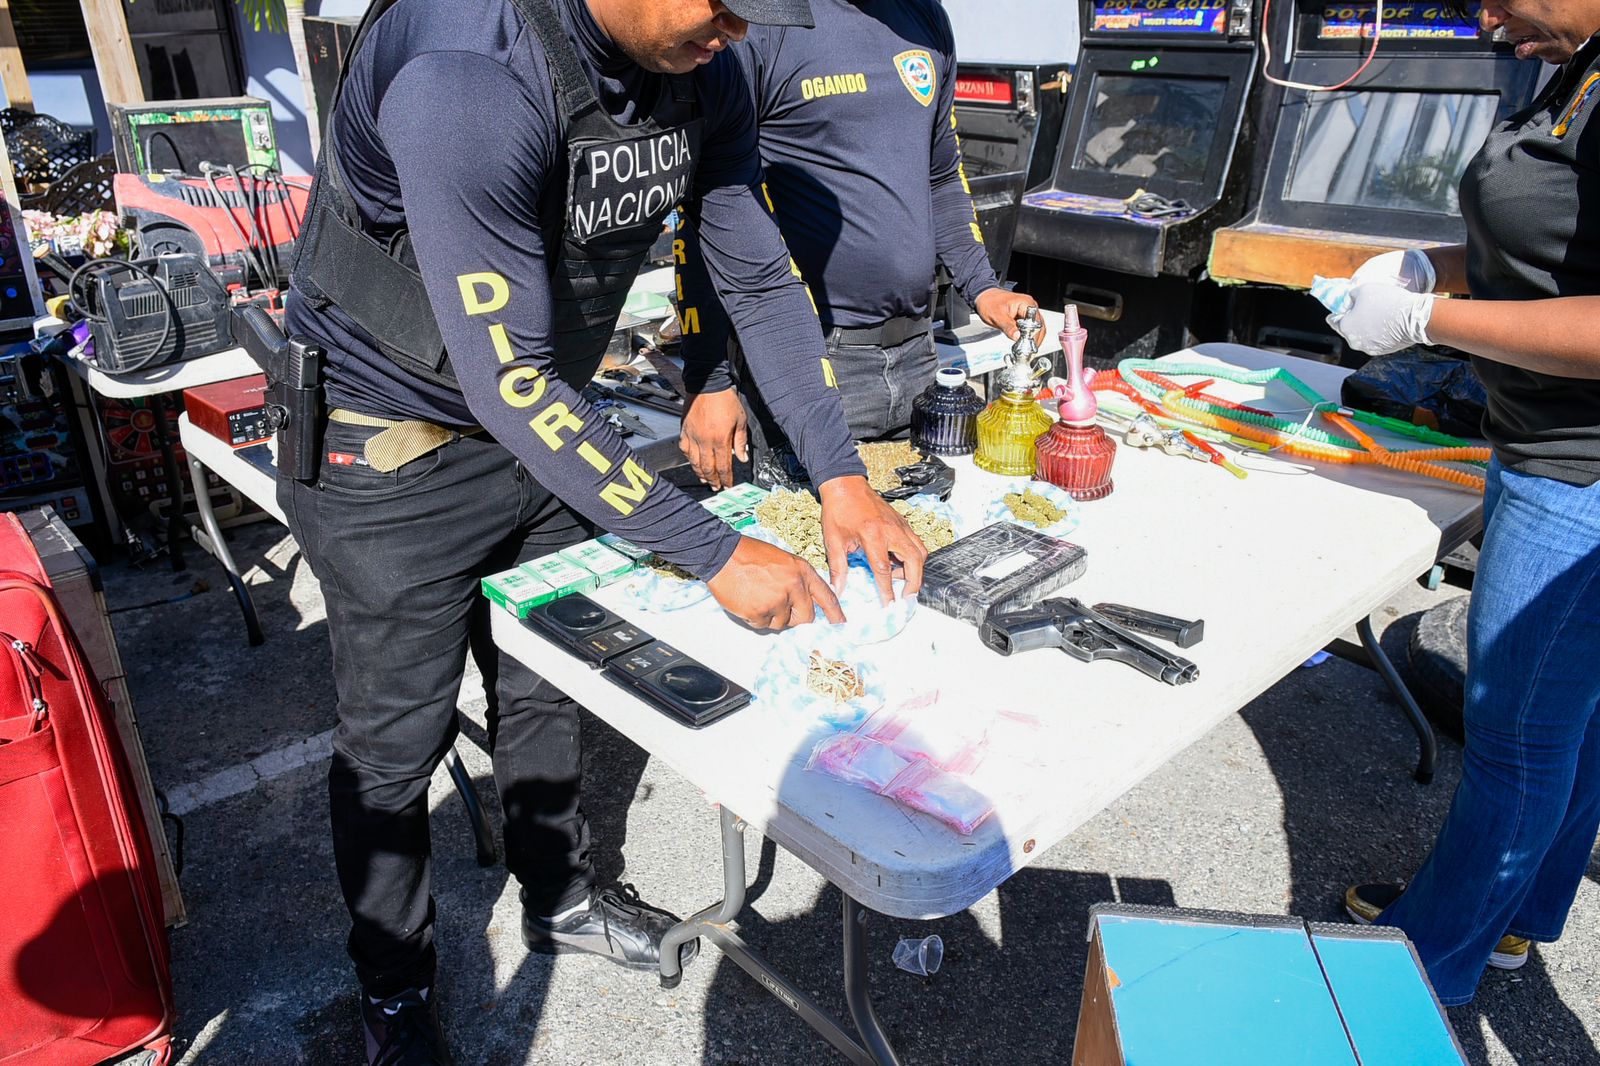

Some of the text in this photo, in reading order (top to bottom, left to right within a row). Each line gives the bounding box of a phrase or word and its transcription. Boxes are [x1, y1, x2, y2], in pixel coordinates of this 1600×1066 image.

[1382, 8, 1413, 18] OF
[801, 72, 867, 100] OGANDO
[955, 80, 985, 94] ARZAN
[590, 128, 691, 189] POLICIA
[456, 271, 654, 516] DICRIM
[765, 977, 795, 1006] LIFETIME
